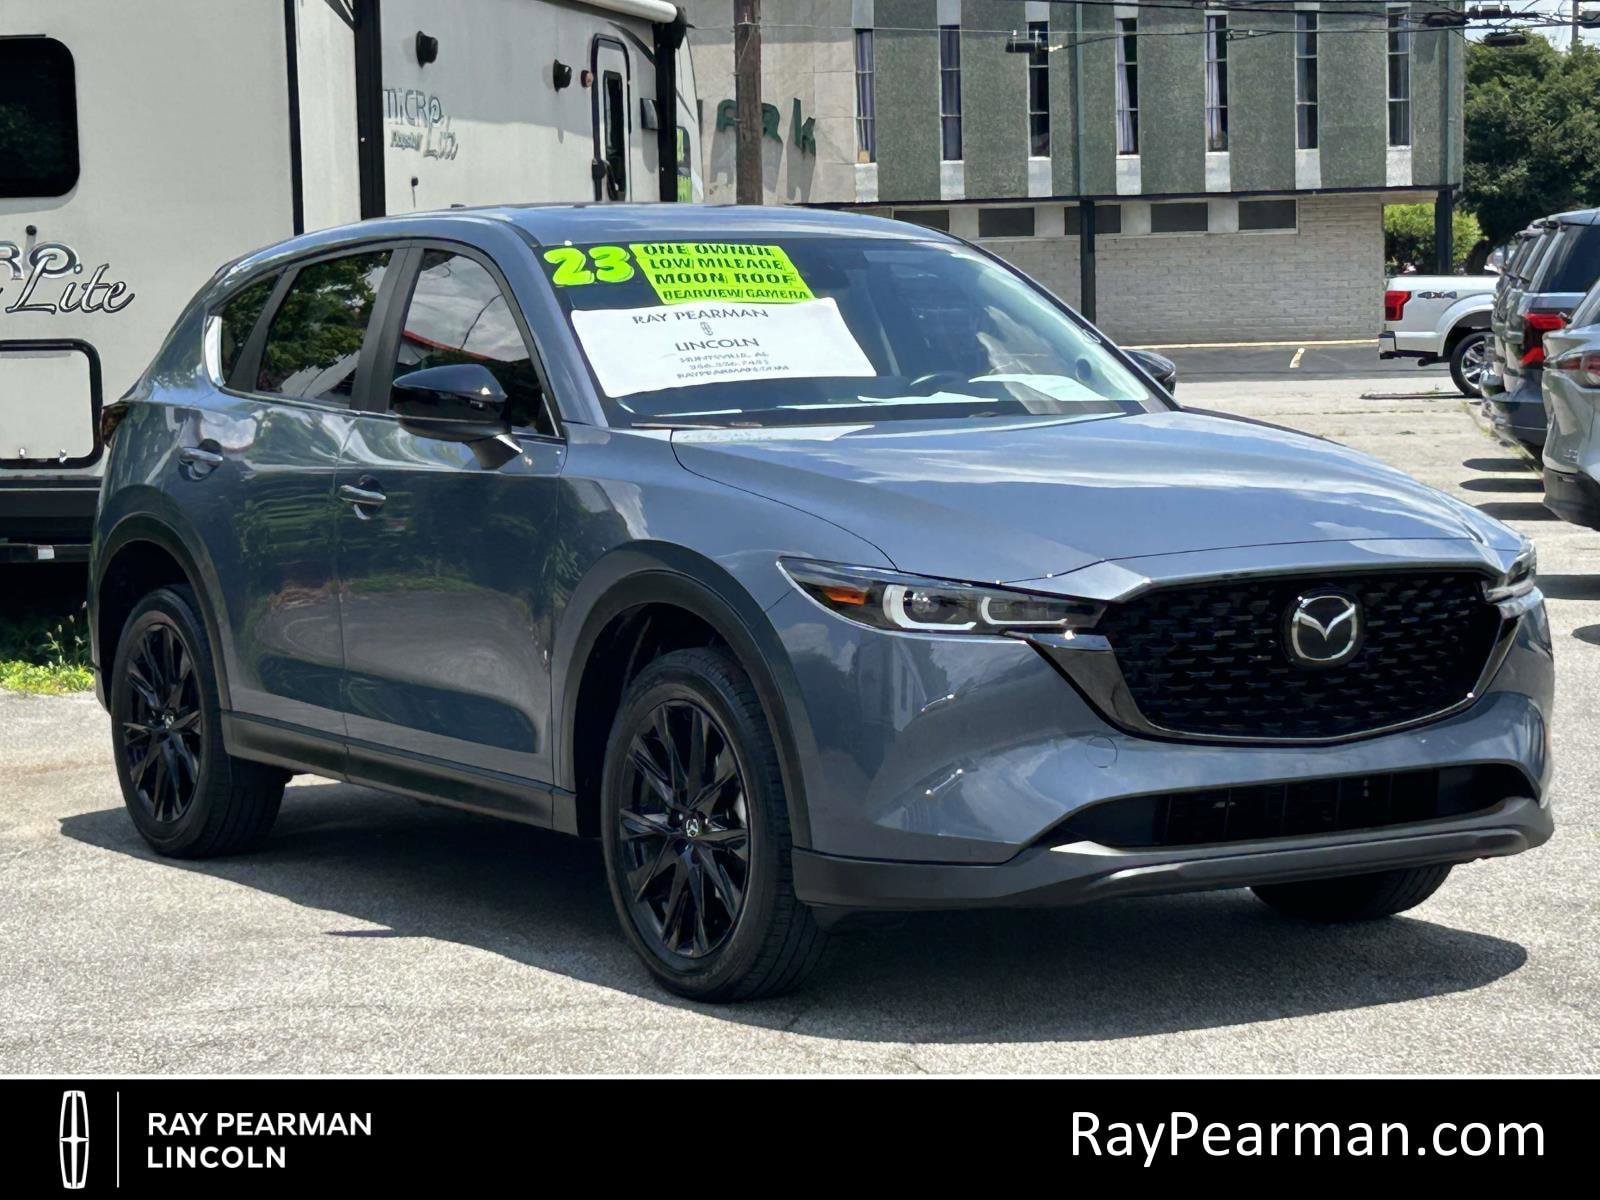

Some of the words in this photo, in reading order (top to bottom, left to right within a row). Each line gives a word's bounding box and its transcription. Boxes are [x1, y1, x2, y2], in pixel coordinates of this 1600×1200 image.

[643, 245, 688, 256] ONE
[695, 245, 773, 256] OWNER
[543, 246, 634, 287] 23
[650, 258, 692, 270] LOW
[699, 258, 783, 270] MILEAGE
[5, 254, 136, 315] Lite
[654, 273, 725, 285] MOON
[734, 273, 795, 284] ROOF
[663, 290, 741, 300] REARVIEW
[745, 289, 810, 300] CAMERA
[632, 312, 667, 324] RAY
[675, 309, 769, 321] PEARMAN
[674, 338, 760, 351] LINCOLN
